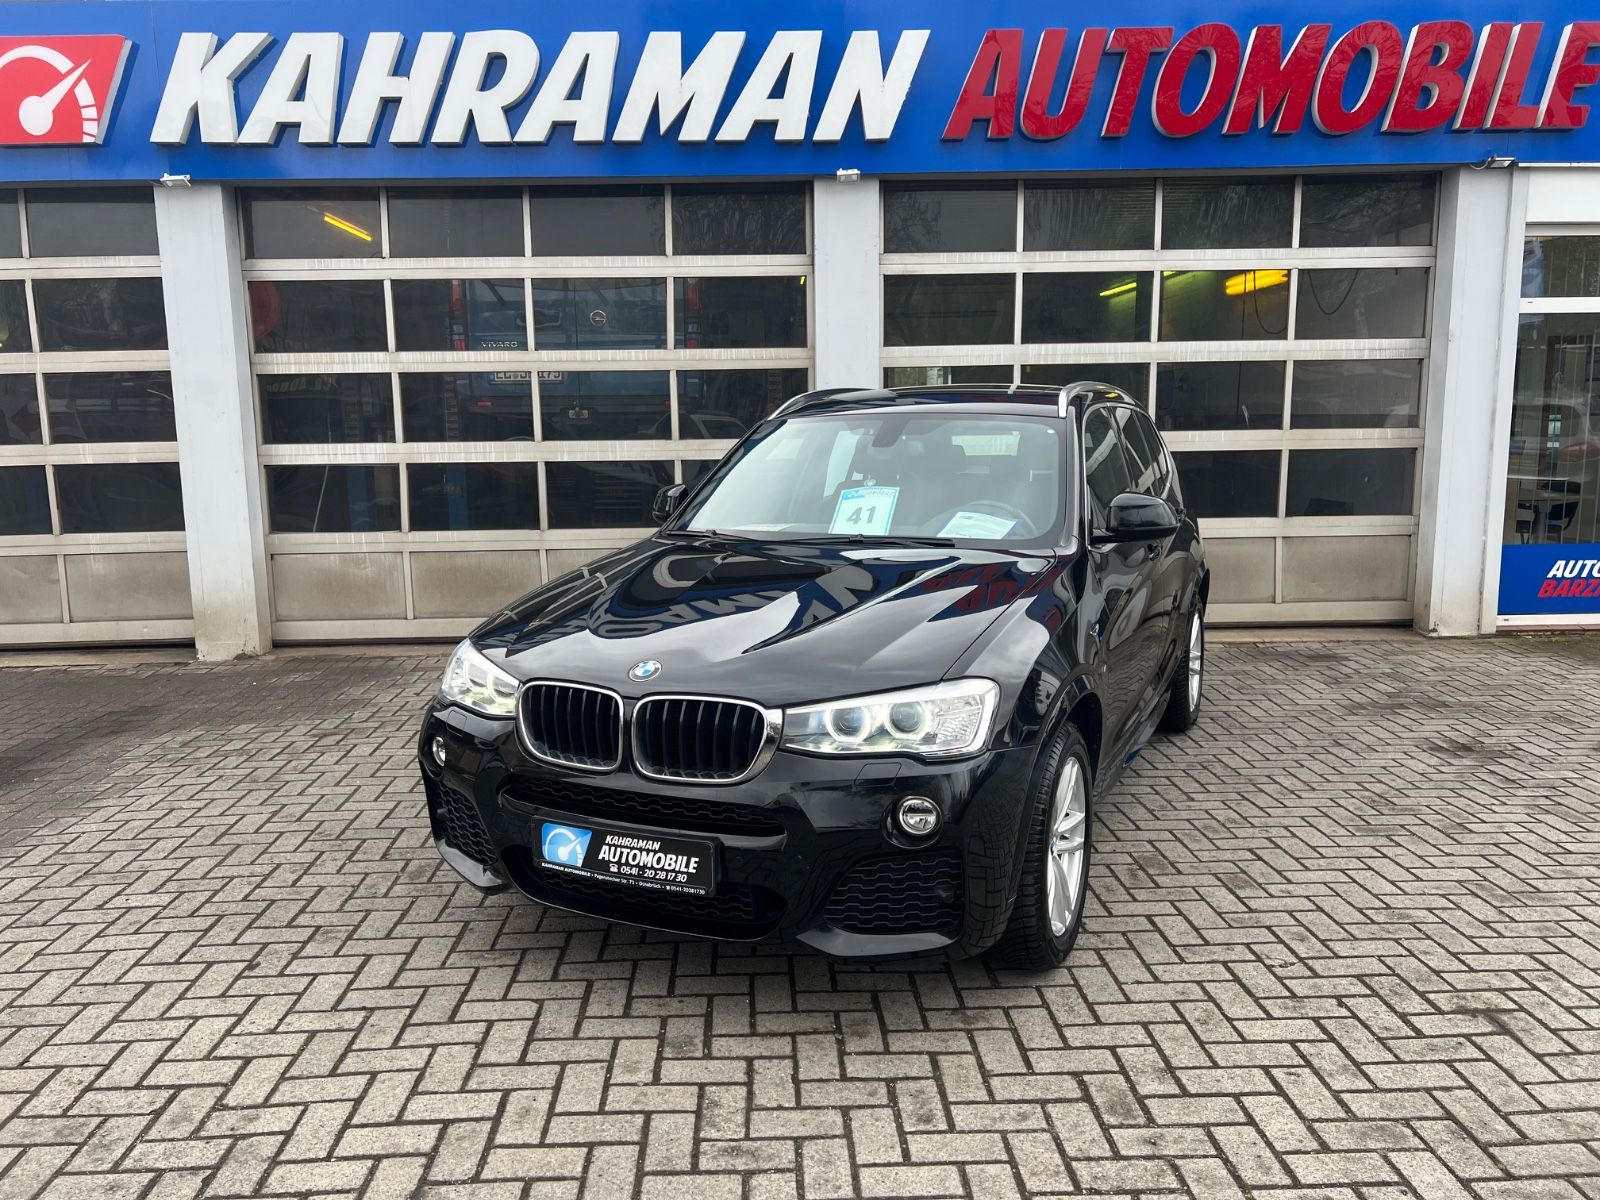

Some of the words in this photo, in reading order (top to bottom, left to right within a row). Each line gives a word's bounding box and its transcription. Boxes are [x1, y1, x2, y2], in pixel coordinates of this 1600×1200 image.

[149, 28, 931, 146] KAHRAMAN
[941, 20, 1600, 141] AUTOMOBILE
[846, 506, 877, 525] 41
[605, 835, 661, 851] KAHRAMAN
[598, 844, 699, 873] AUTOMOBILE
[541, 862, 564, 871] KAHRAMAN
[564, 867, 591, 877] AUTOMOBILE
[620, 865, 639, 876] 0541
[643, 869, 655, 878] 20
[655, 871, 667, 880] 28
[667, 872, 676, 881] 17
[676, 873, 687, 882] 30
